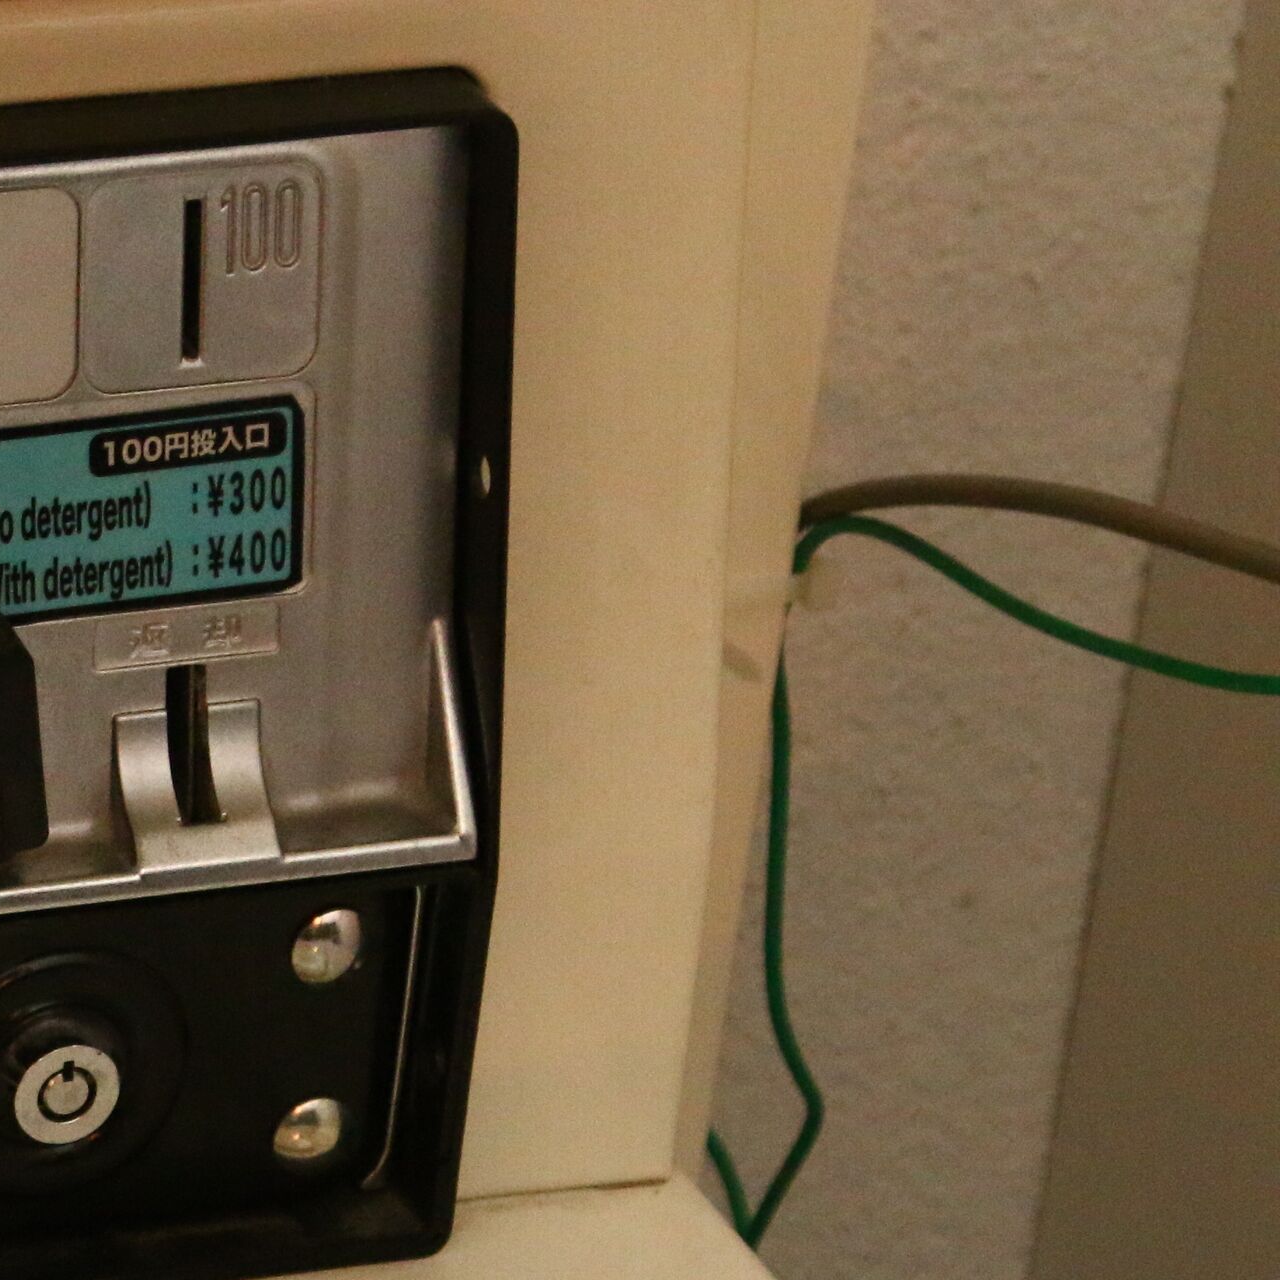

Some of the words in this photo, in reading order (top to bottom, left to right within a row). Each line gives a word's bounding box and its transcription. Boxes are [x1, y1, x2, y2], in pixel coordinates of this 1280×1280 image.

[220, 179, 302, 278] 100
[104, 421, 271, 468] 100円投入口
